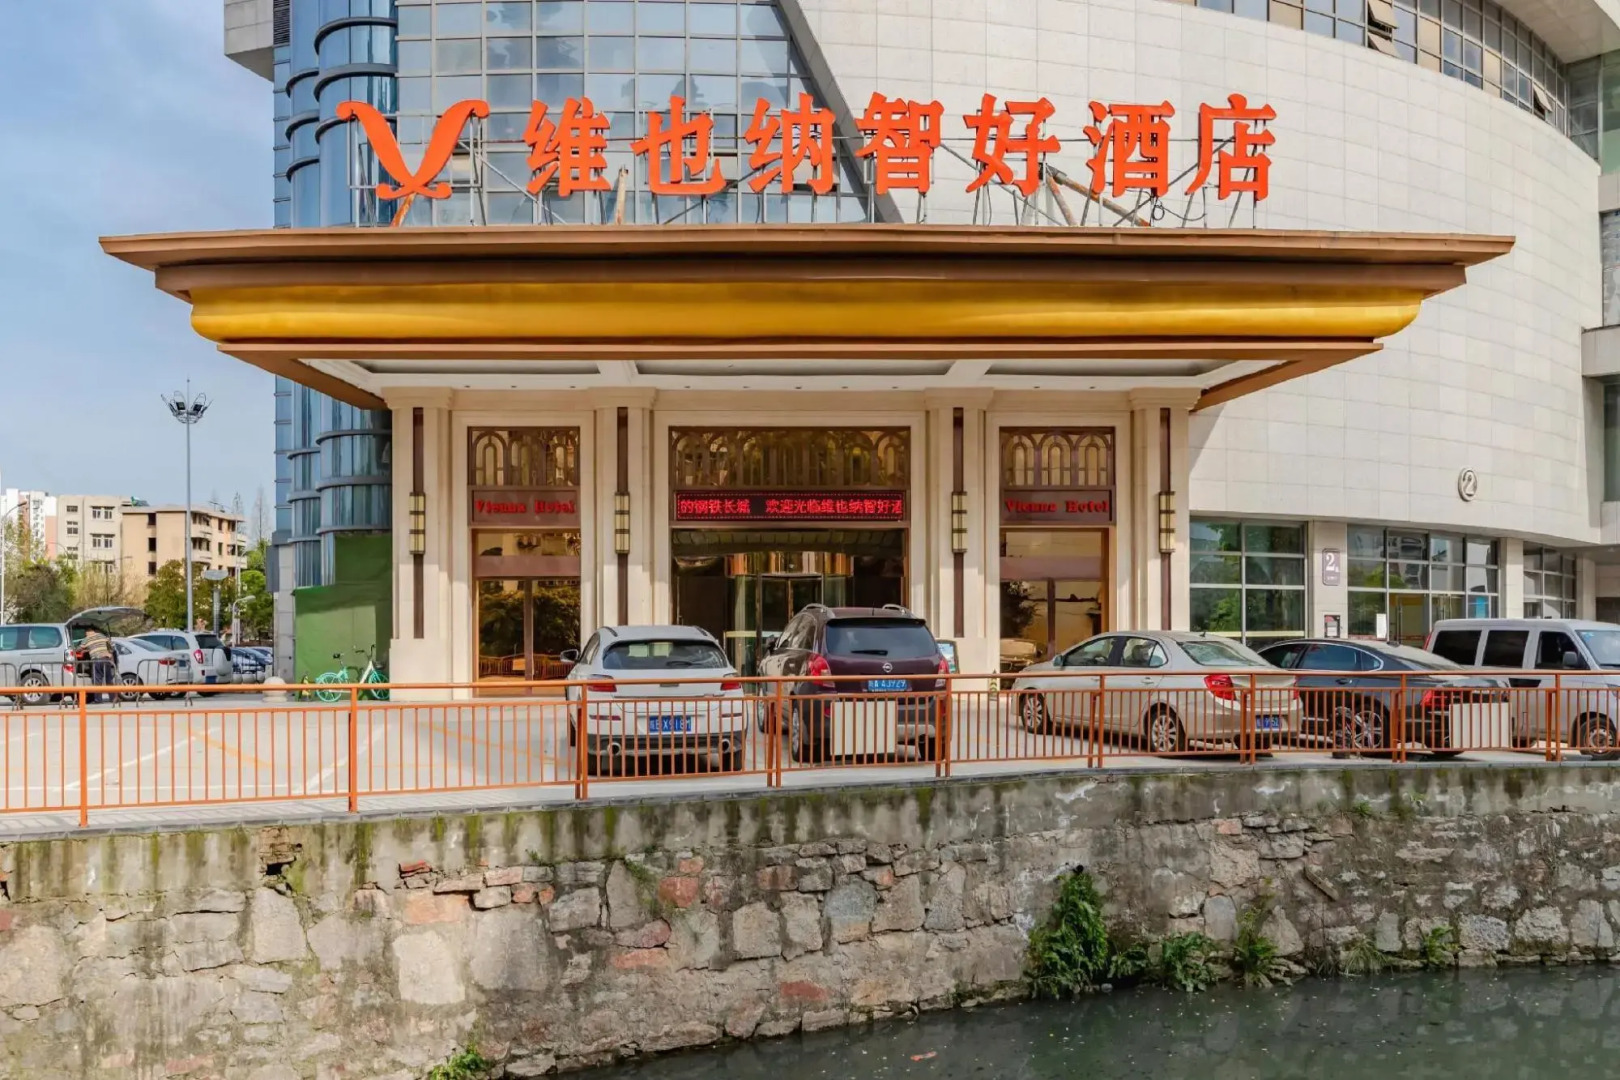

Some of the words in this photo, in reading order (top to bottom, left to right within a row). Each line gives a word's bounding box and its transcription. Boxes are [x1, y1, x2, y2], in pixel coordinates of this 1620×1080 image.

[524, 94, 1275, 199] 维也纳智好酒店
[475, 499, 527, 514] Vienna
[534, 499, 576, 514] Hotel
[1004, 499, 1057, 513] Vienna
[1065, 499, 1109, 513] Hotel
